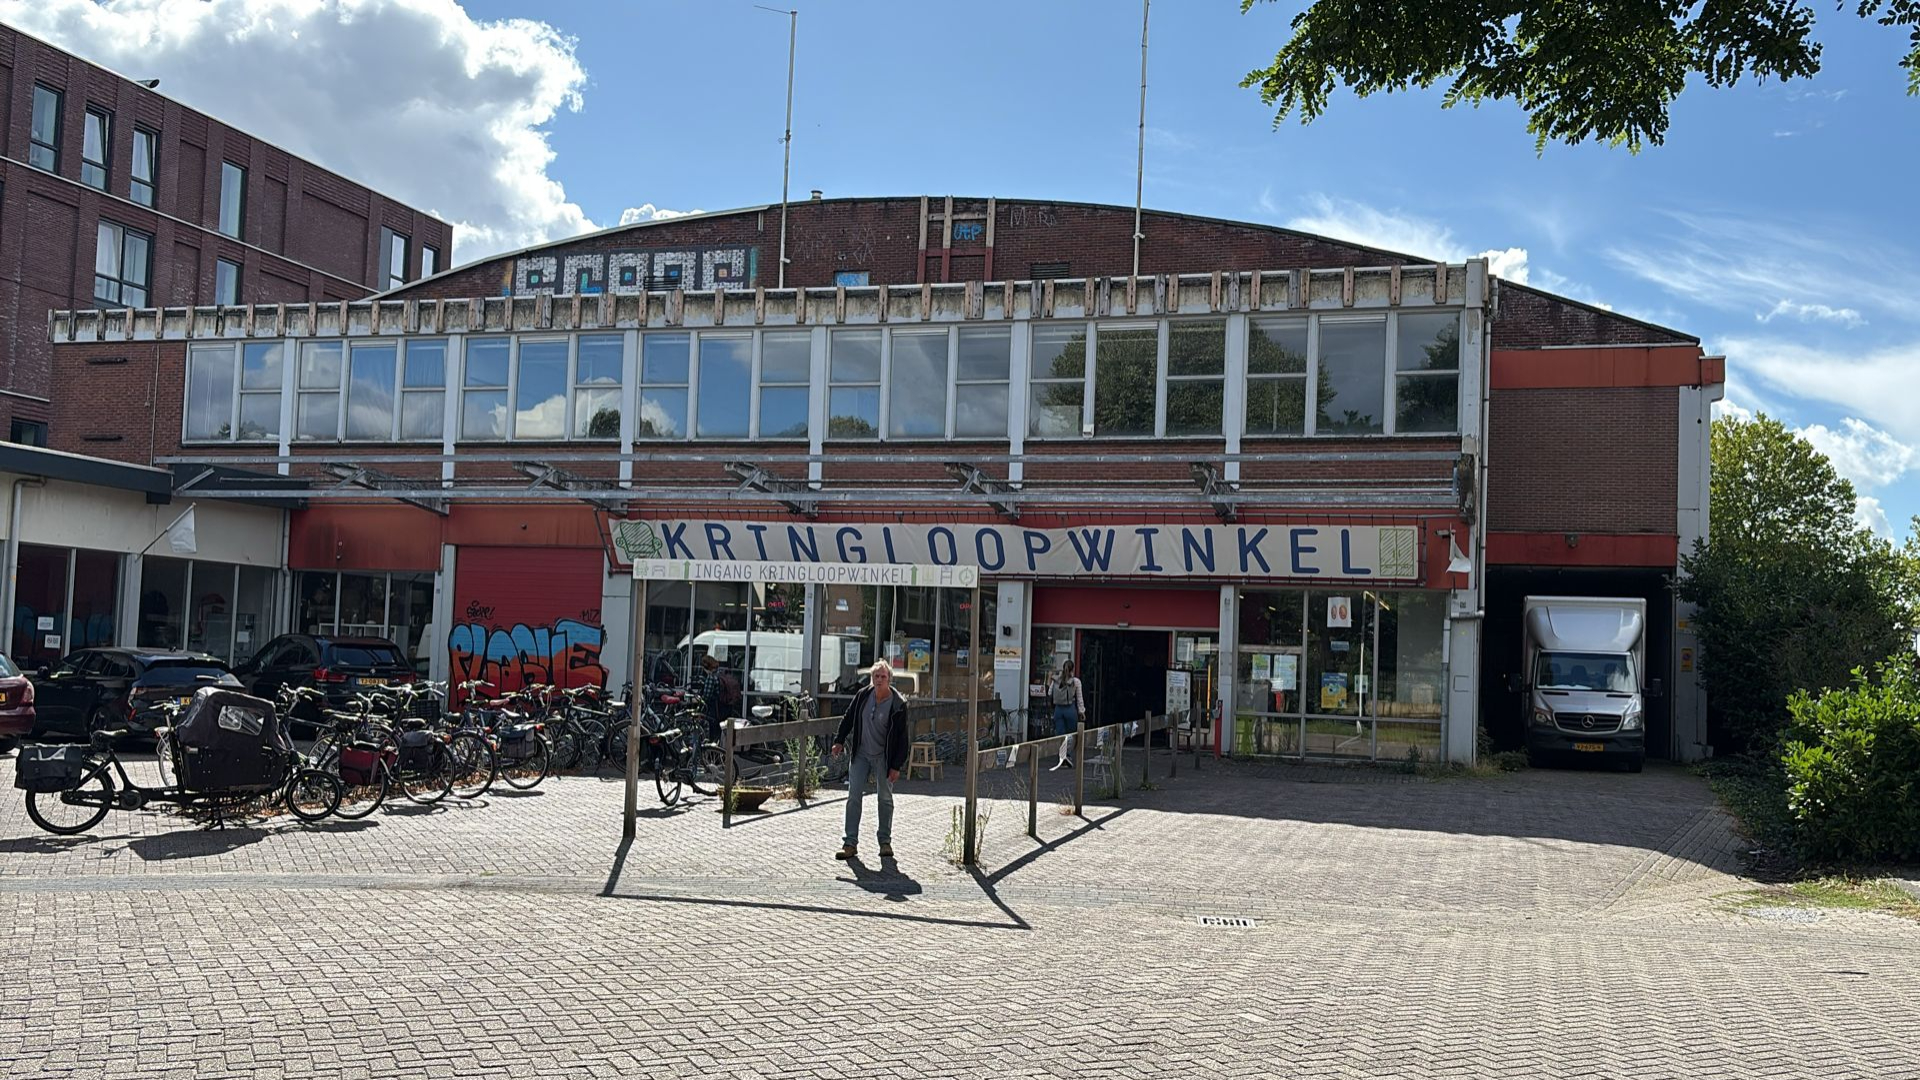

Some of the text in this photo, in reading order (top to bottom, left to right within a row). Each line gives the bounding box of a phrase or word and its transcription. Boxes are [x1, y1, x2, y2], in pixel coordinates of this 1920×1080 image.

[661, 522, 1371, 575] KRINGLOOPWINKEL
[695, 563, 909, 584] INGANG KRINGLOOPWINKEL
